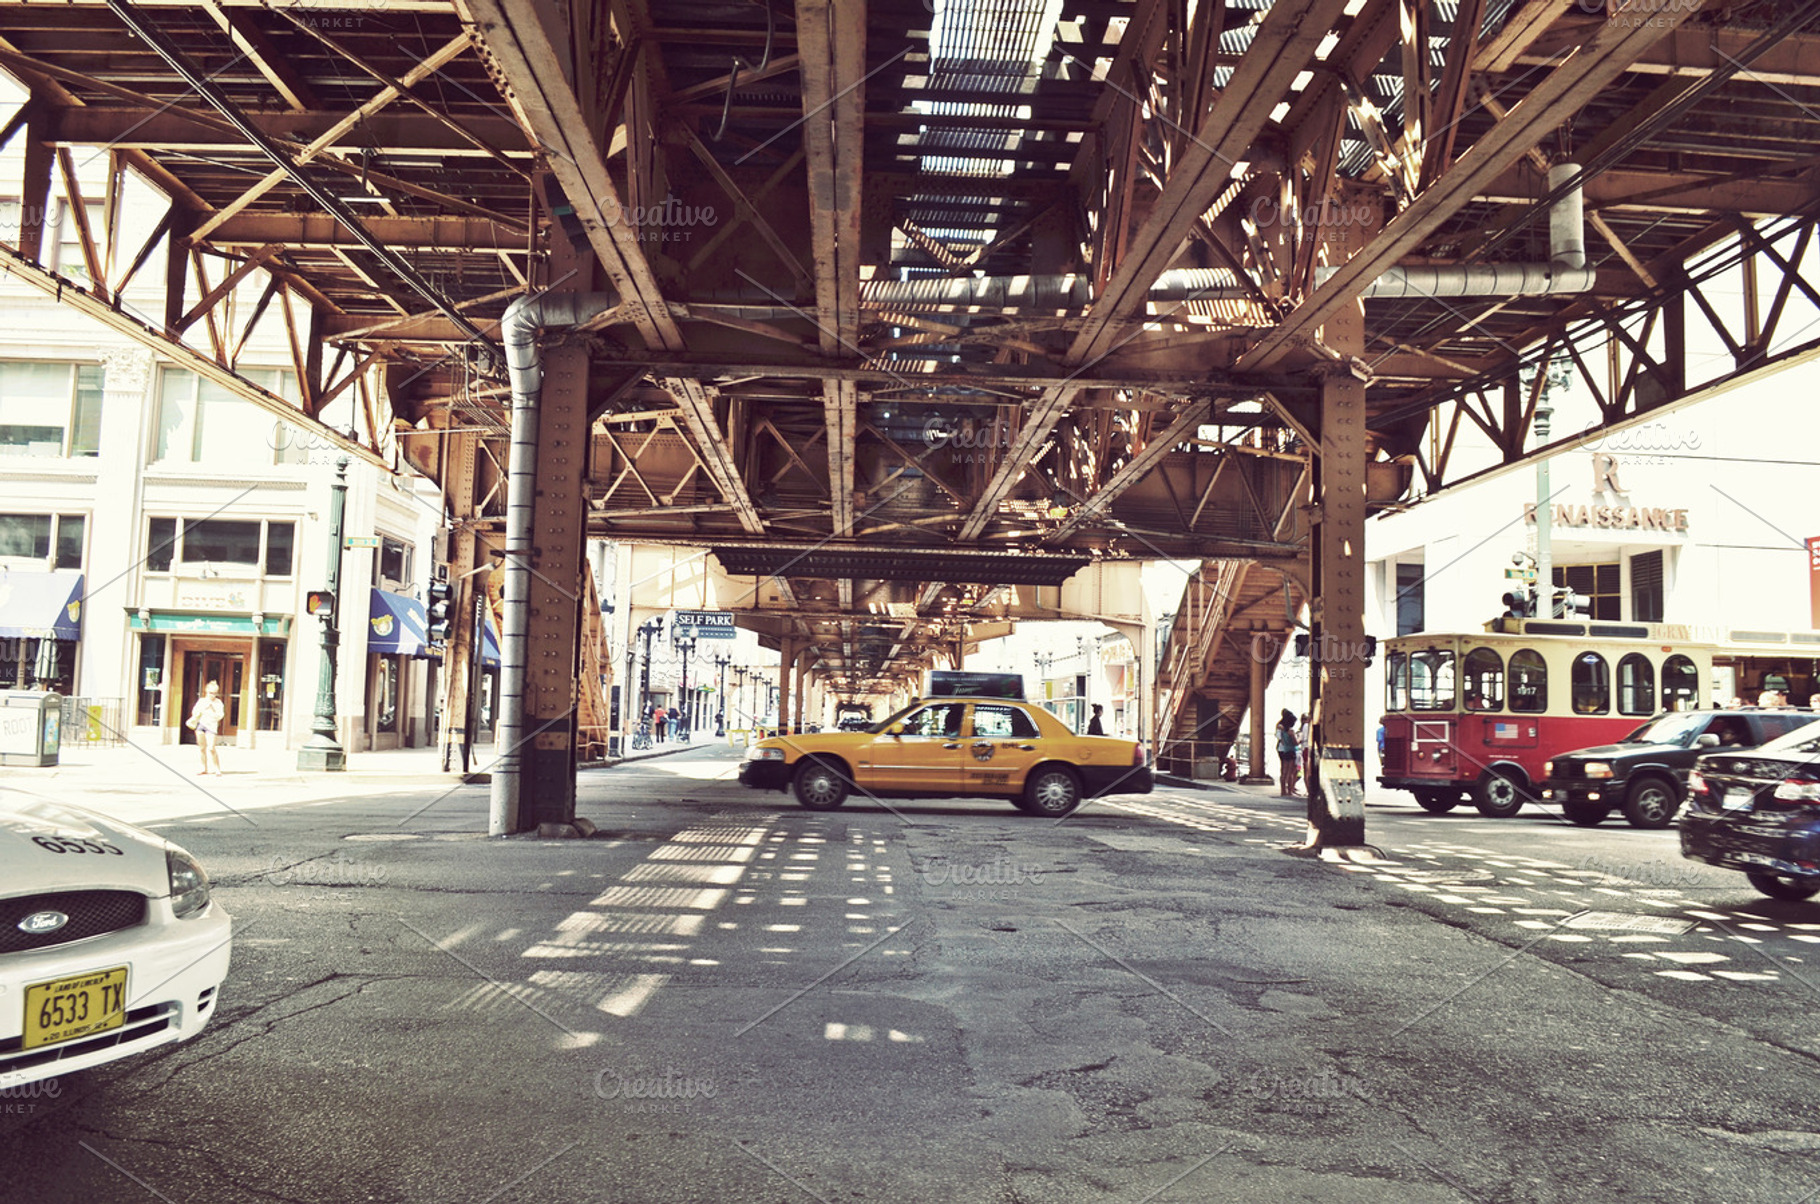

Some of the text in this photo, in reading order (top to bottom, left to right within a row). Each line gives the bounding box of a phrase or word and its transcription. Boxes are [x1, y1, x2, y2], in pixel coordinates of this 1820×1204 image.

[1592, 452, 1631, 493] R
[1524, 503, 1689, 531] RNAISSANCE
[679, 614, 732, 626] SELF PARK
[3, 717, 33, 737] ROOT
[31, 912, 58, 930] Ford
[54, 977, 104, 993] LAND OF LINCOLN
[39, 982, 123, 1029] 6533 TX
